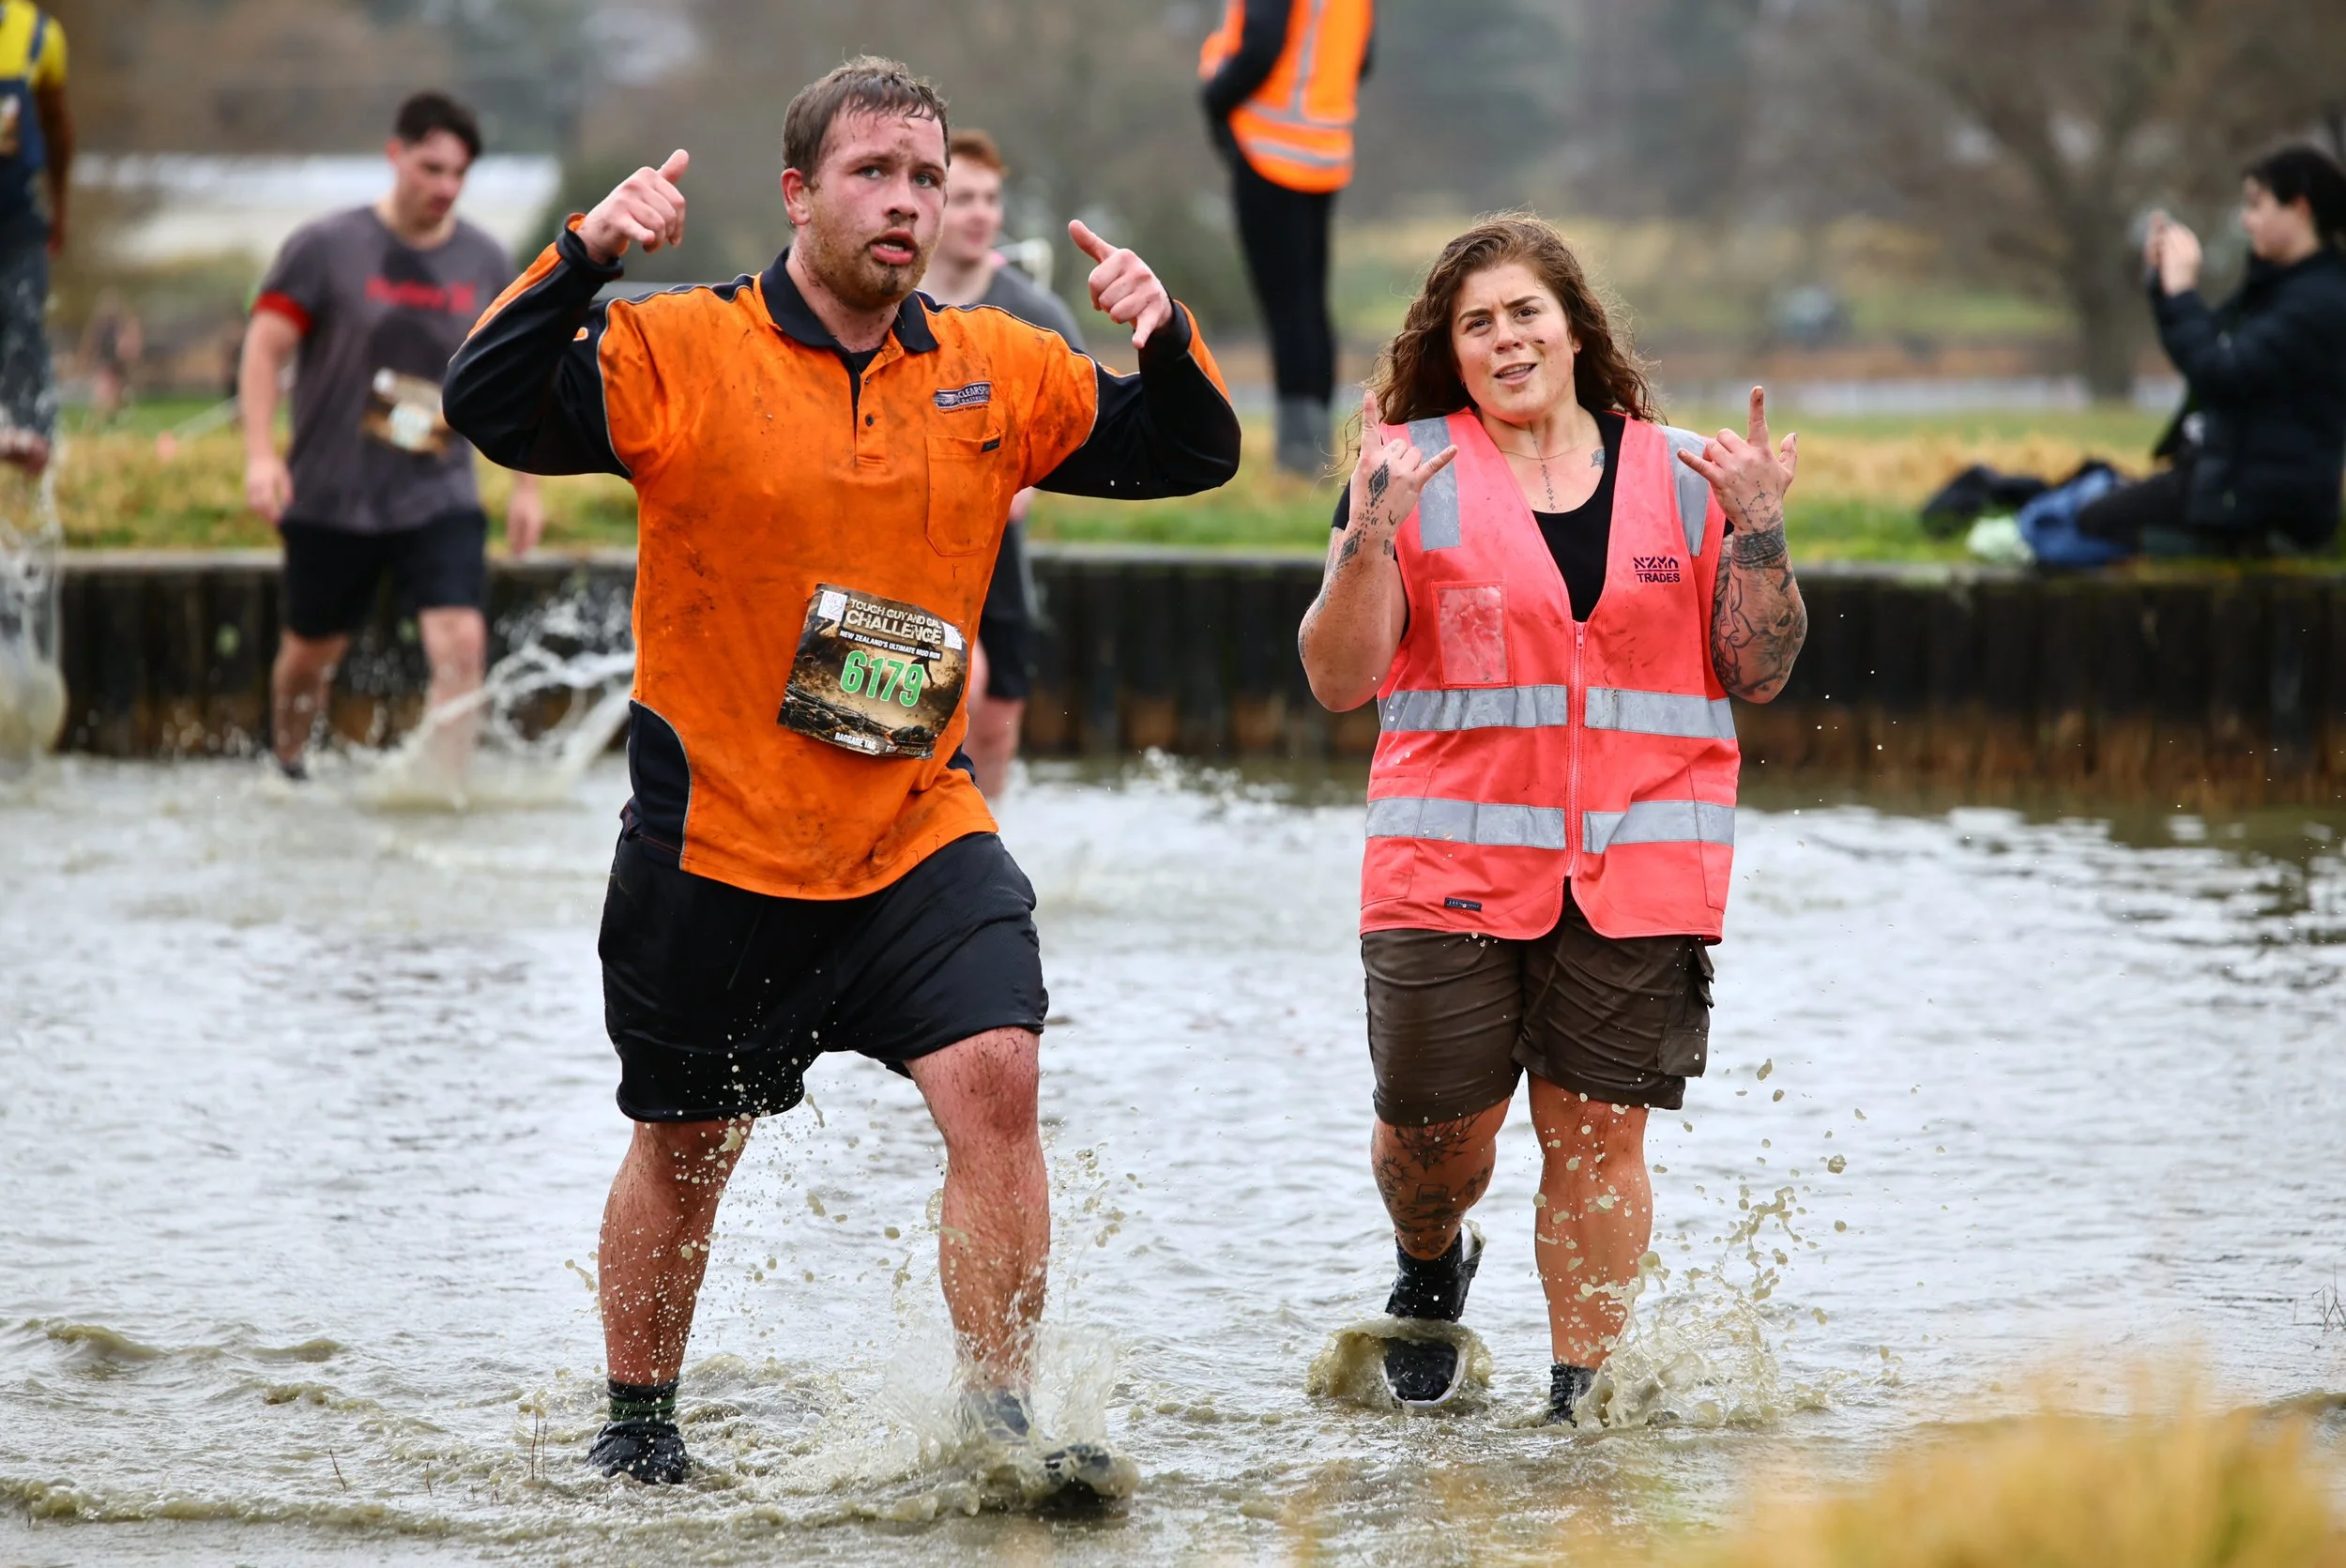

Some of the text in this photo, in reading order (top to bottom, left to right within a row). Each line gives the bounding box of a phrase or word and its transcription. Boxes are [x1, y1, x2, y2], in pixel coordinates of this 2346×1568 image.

[1637, 572, 1681, 583] TRADES
[845, 609, 941, 645] CHALLENGE
[850, 599, 884, 617] TOUGH
[886, 609, 907, 620] GUY
[906, 614, 925, 624] AND
[926, 617, 941, 629] GAL
[839, 630, 855, 640] NEW
[855, 633, 889, 648] ZEALAND'S
[889, 643, 916, 654] ULTIMATE
[916, 647, 929, 657] MUD
[840, 649, 924, 708] 6179
[834, 732, 863, 747] BAGGAGE
[864, 739, 876, 751] TAG
